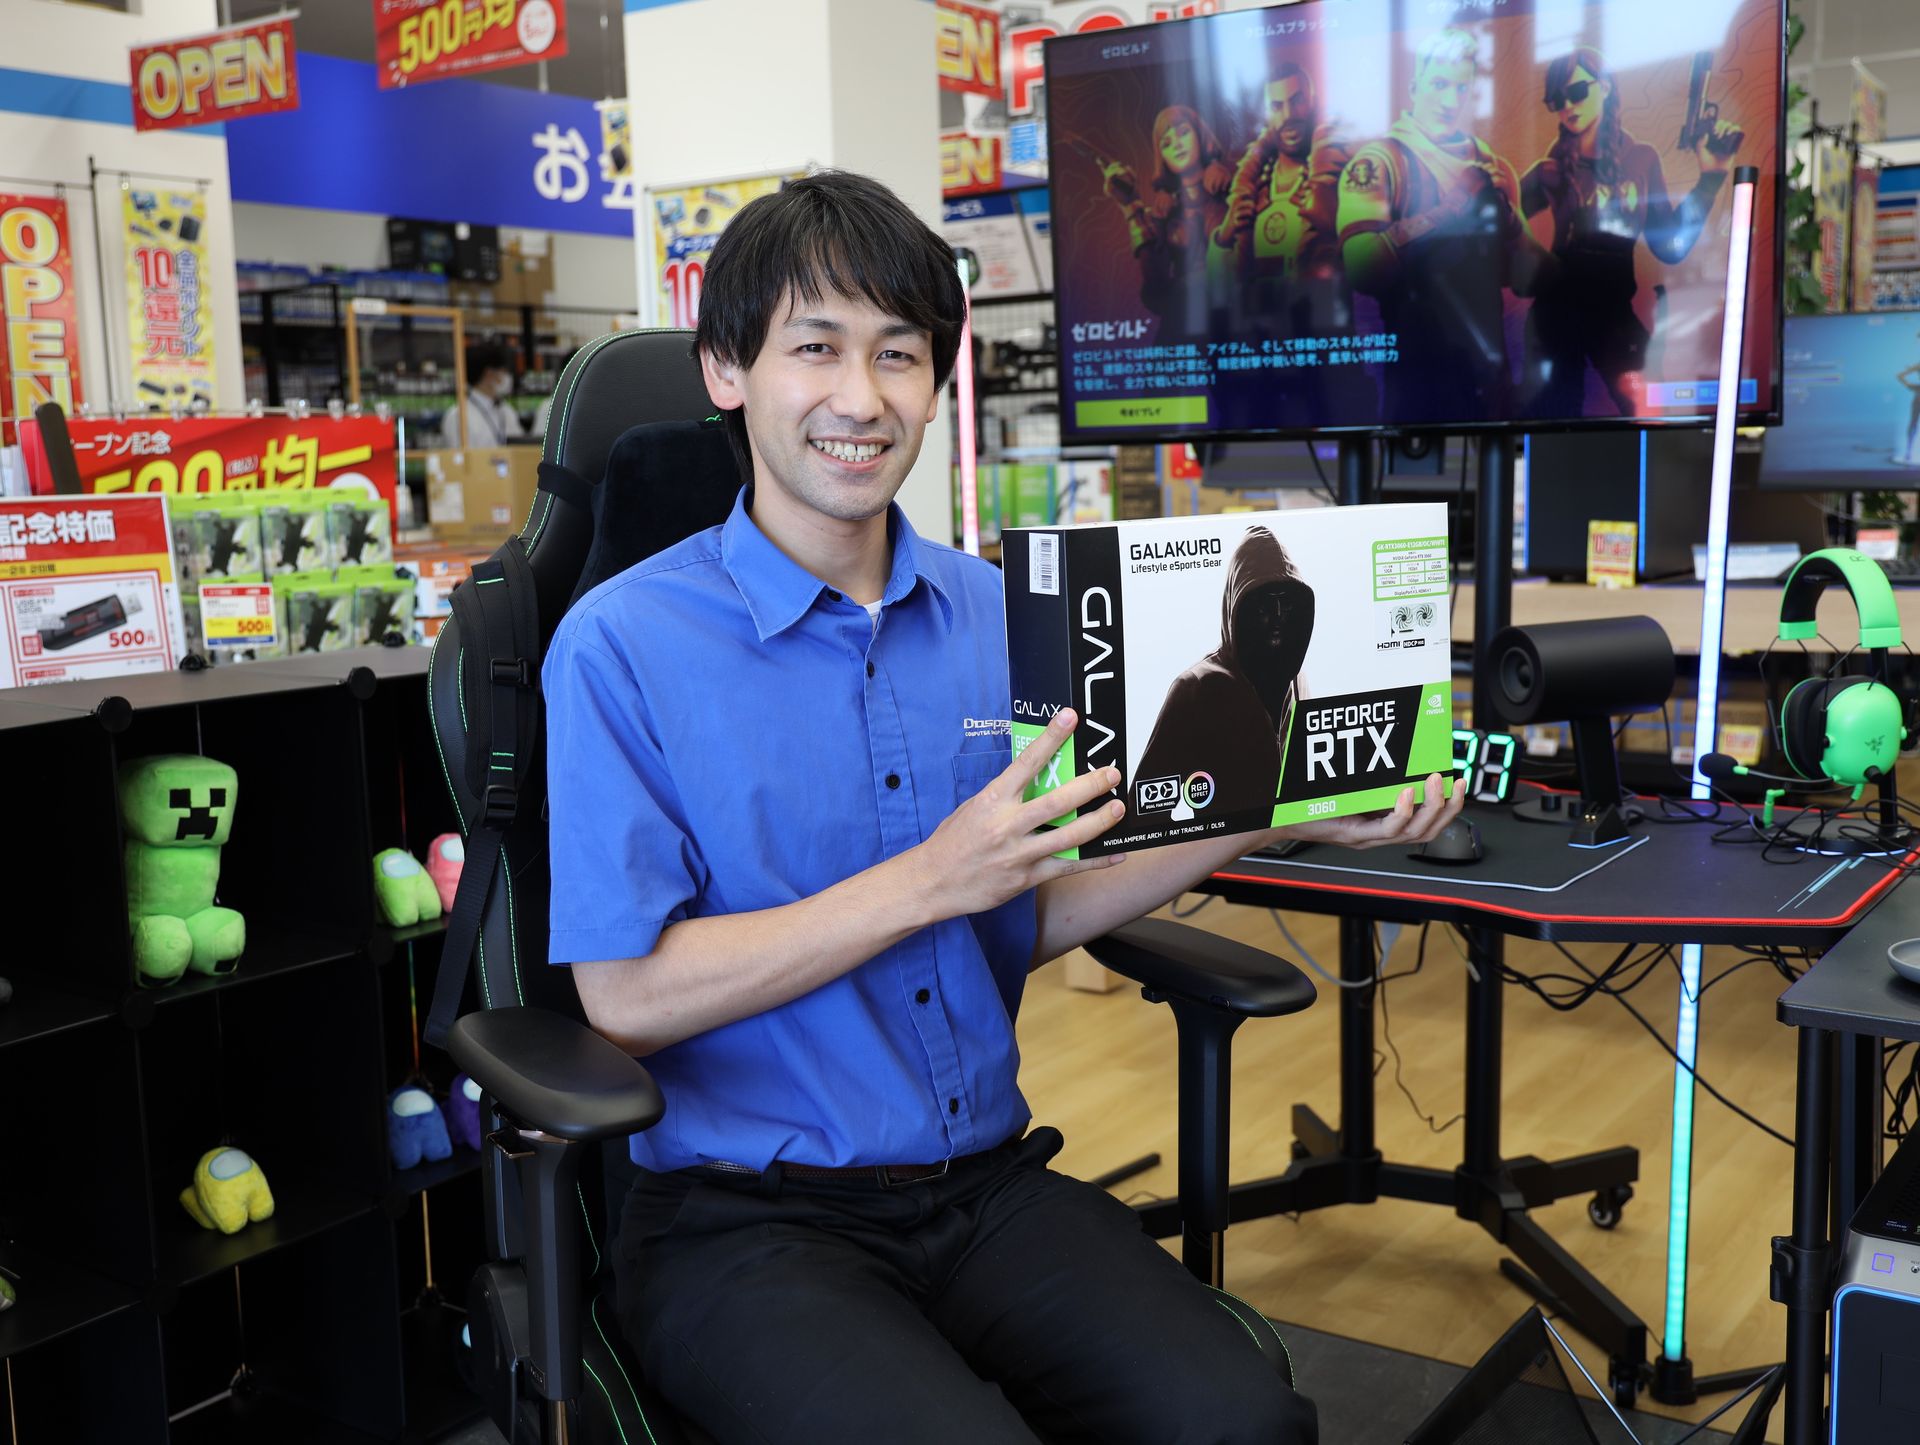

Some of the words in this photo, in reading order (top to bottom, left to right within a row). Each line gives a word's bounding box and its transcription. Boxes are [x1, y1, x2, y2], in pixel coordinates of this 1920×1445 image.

[139, 31, 288, 119] OPEN
[0, 207, 72, 416] OPEN
[1071, 319, 1152, 343] ゼロビルド
[70, 430, 171, 456] ープン記念
[1130, 538, 1221, 561] GALAKURO
[1131, 562, 1167, 574] Lifestyle
[1169, 560, 1201, 571] eSports
[1202, 558, 1222, 568] Gear
[1377, 641, 1400, 649] HDMI
[1013, 699, 1062, 718] GALAX
[1305, 700, 1396, 732] GEFORCE
[1306, 723, 1396, 782] RTX
[1191, 782, 1208, 793] RGB
[1191, 790, 1209, 799] EFFECT
[1307, 800, 1336, 816] 3060
[1103, 838, 1123, 847] NVIDIA
[1124, 834, 1146, 843] AMPERE
[1146, 832, 1163, 840] ARCH
[1181, 825, 1204, 834] TRACING
[1210, 821, 1226, 829] DLSS
